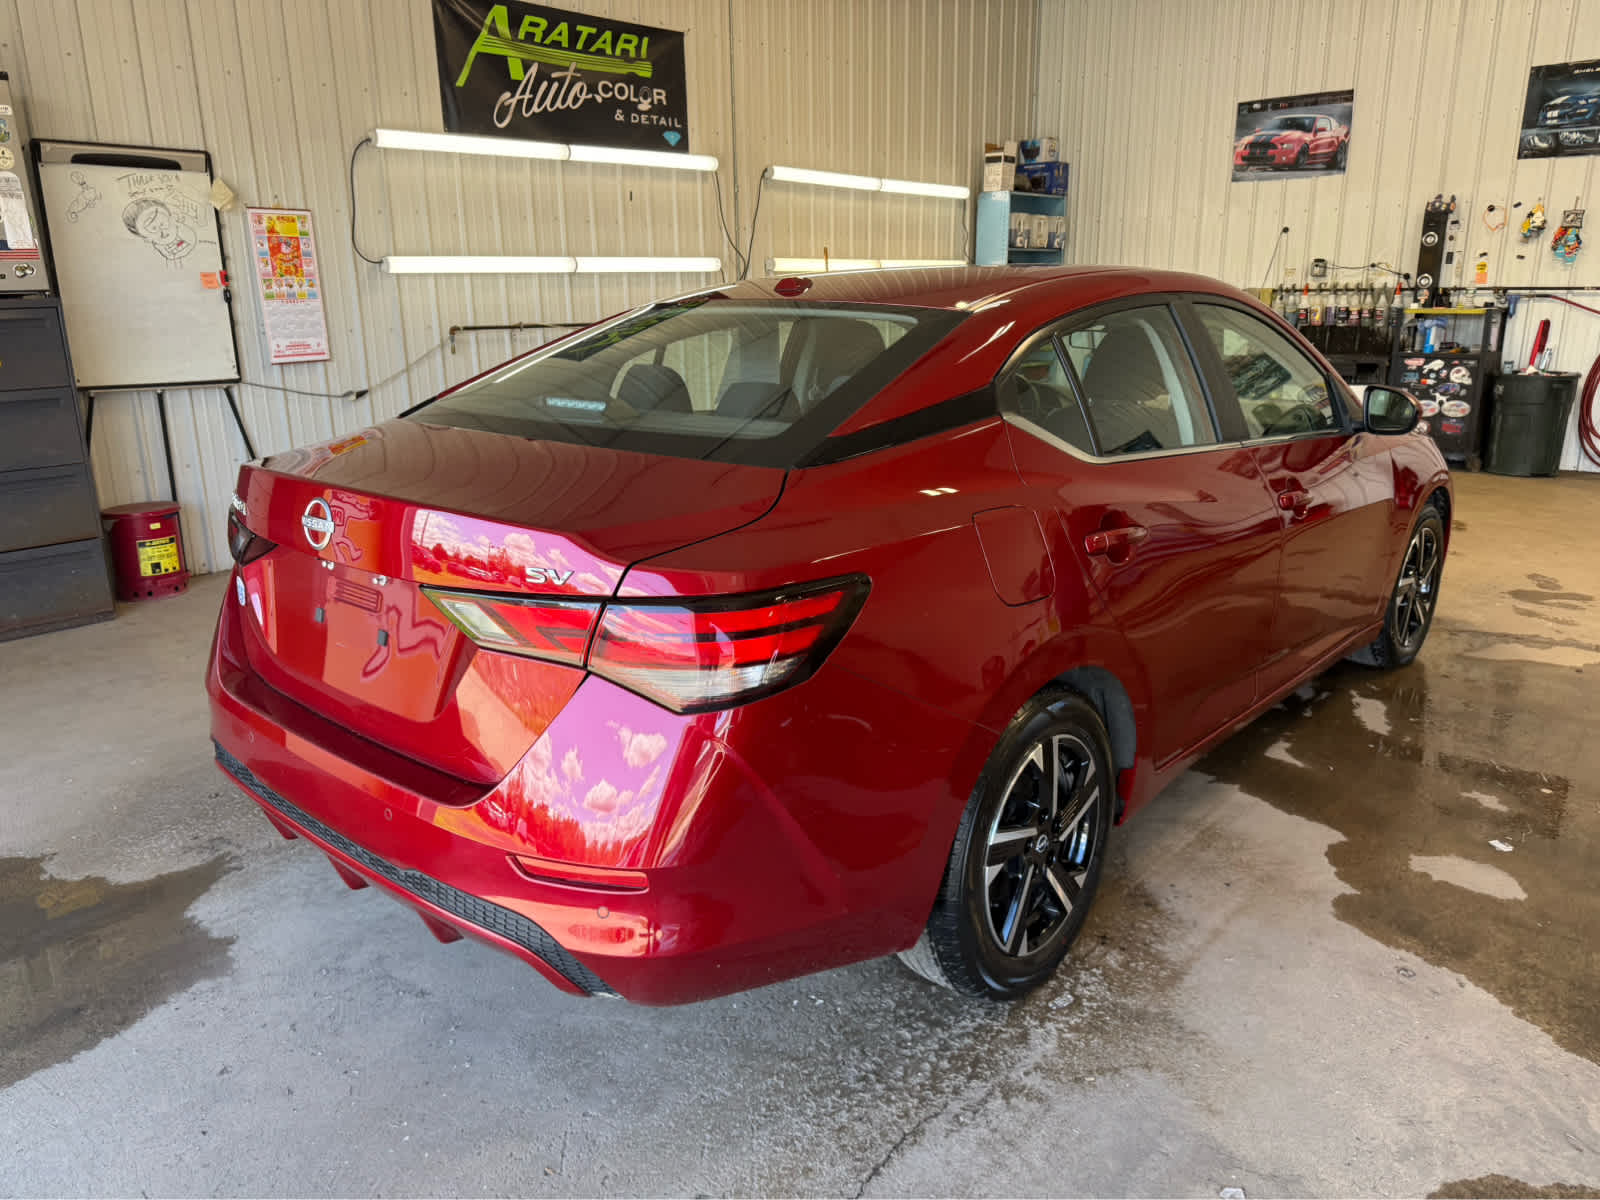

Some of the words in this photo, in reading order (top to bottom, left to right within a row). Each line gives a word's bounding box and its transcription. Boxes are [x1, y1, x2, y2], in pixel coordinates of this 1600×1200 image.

[455, 4, 649, 87] ARATARI
[493, 62, 592, 128] Auto
[597, 80, 667, 106] COLOR
[614, 109, 625, 122] &
[631, 112, 682, 128] DETAIL
[525, 567, 575, 585] SV
